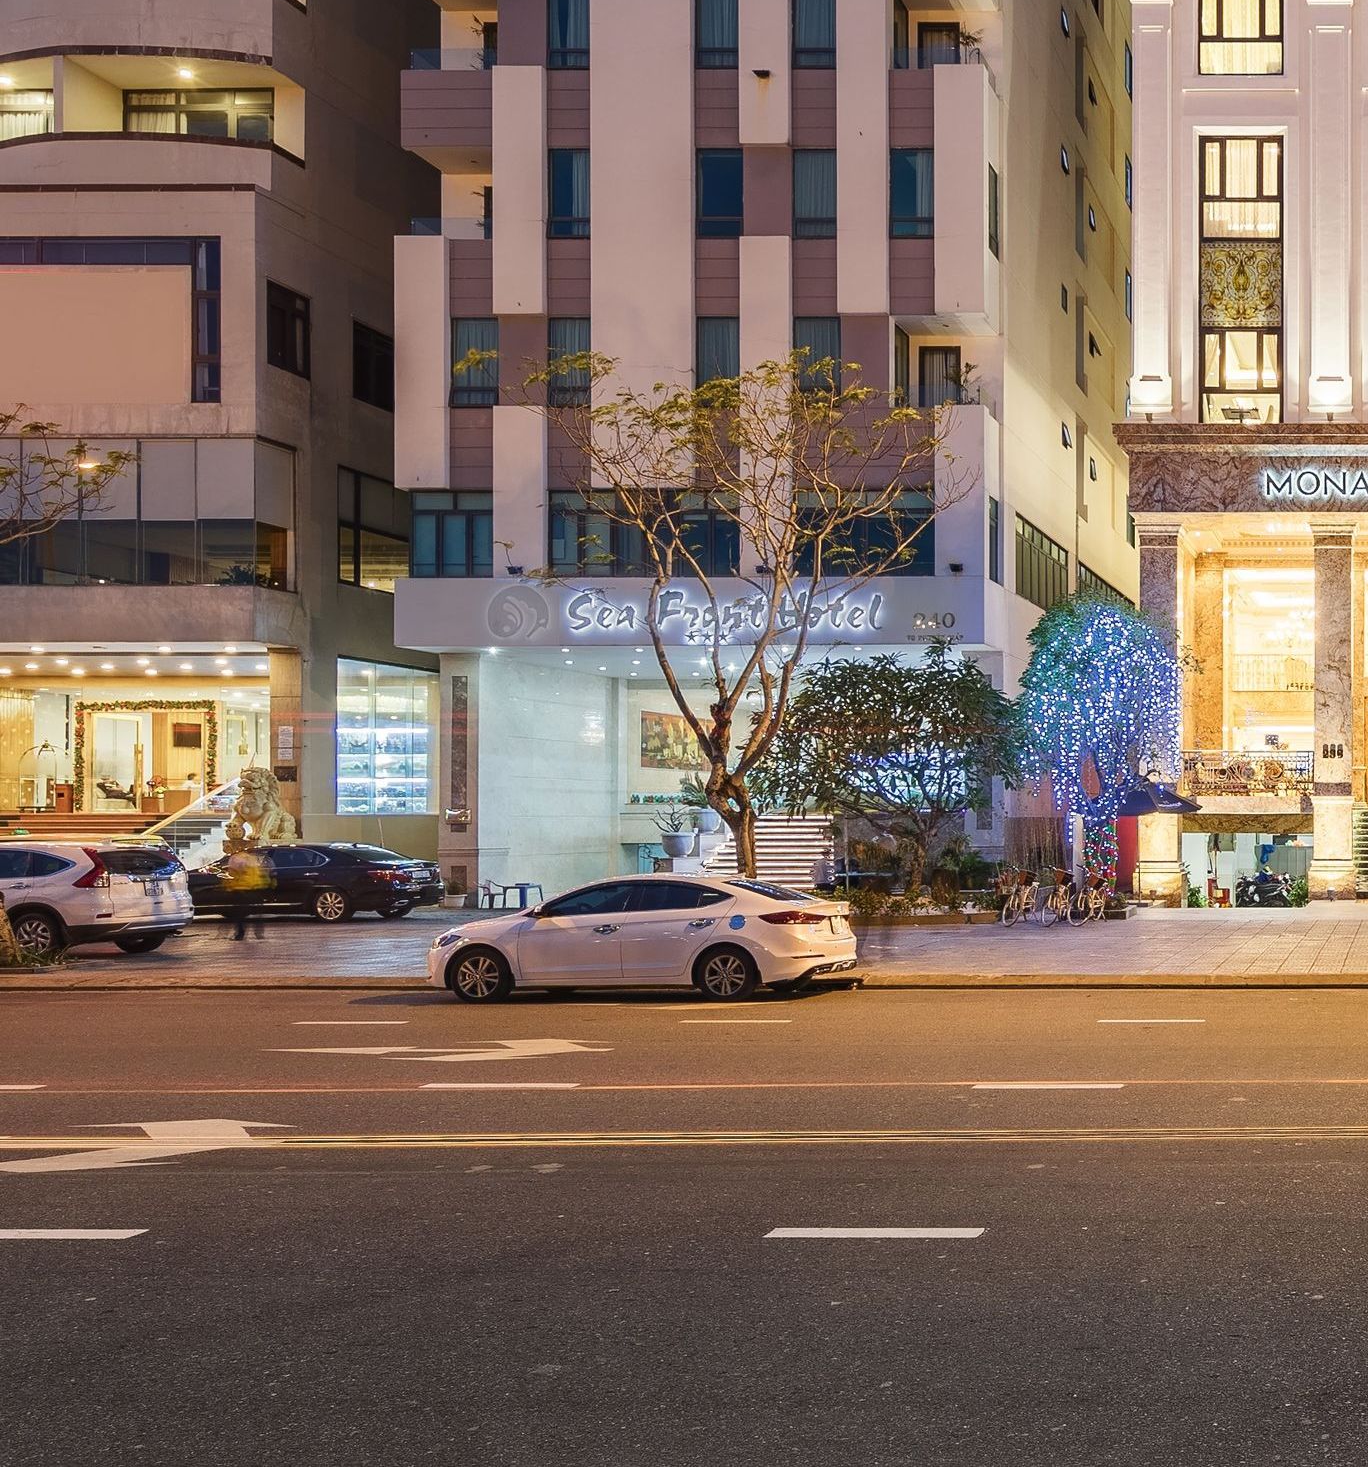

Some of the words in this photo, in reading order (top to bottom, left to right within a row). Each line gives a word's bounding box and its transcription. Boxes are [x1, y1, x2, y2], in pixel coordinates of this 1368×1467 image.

[568, 592, 635, 631] Sea
[648, 590, 765, 634] Front
[776, 591, 884, 631] Hotel
